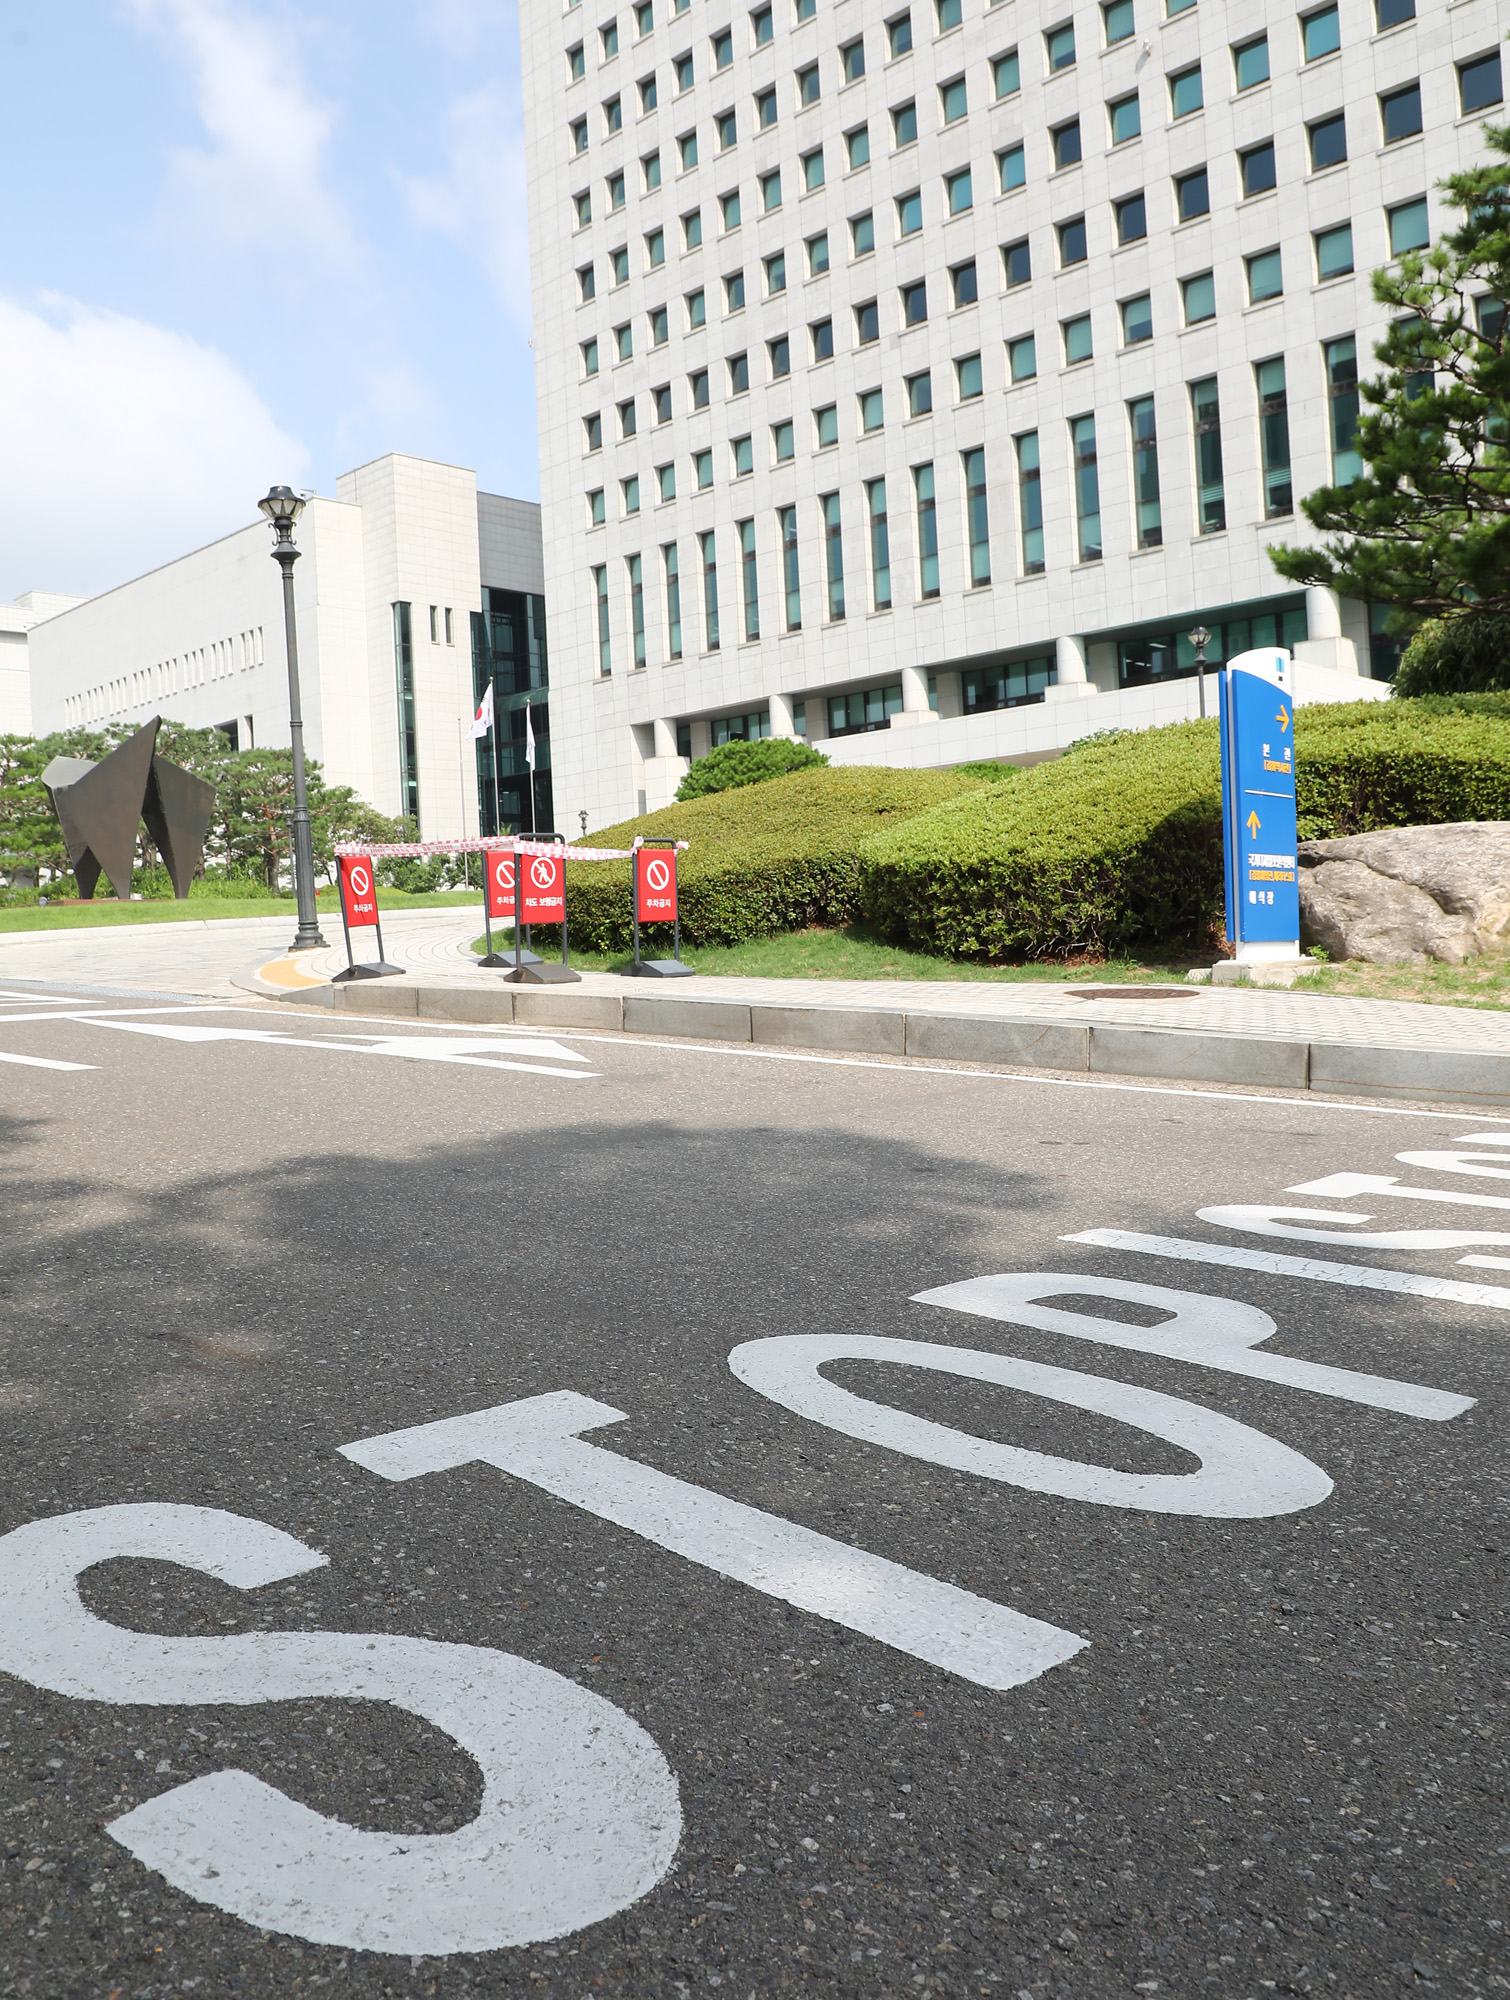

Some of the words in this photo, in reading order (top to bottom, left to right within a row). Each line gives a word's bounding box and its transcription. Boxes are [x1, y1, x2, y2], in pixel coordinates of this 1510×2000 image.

[496, 896, 516, 905] 주차금
[525, 897, 538, 907] 차도
[540, 897, 563, 907] 보행금지
[646, 899, 671, 908] 주차금지
[353, 903, 374, 913] 주차금지
[0, 1272, 1476, 1955] STOP
